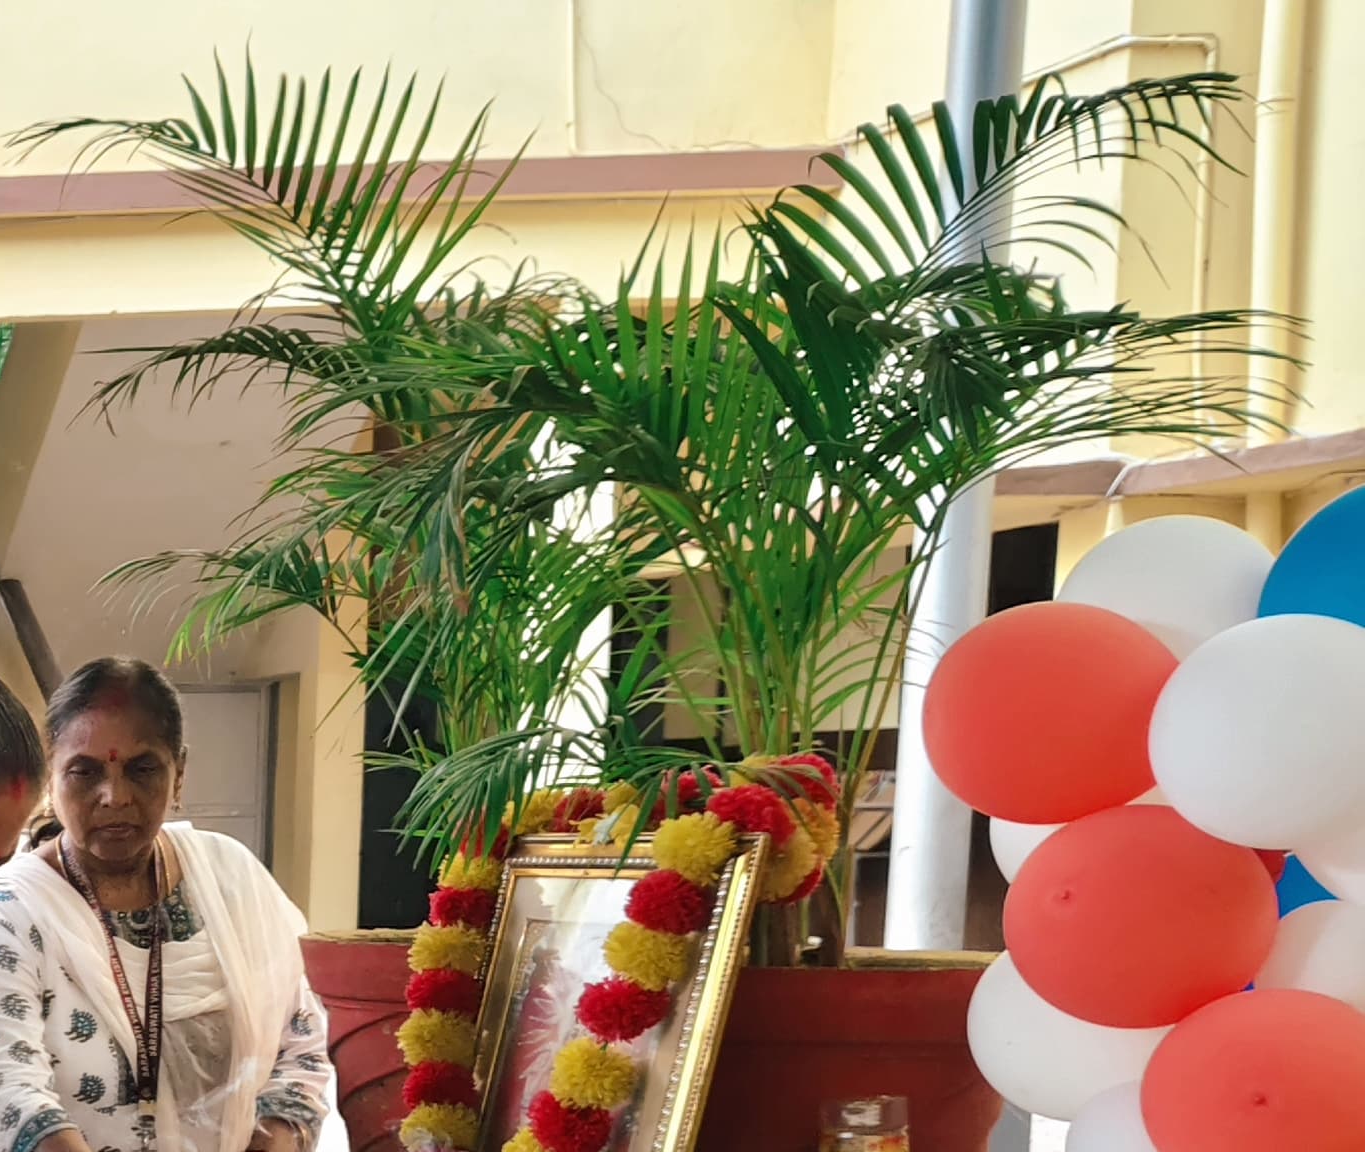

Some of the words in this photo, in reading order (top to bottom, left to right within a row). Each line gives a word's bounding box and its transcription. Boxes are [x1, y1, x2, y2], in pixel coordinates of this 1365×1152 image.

[111, 957, 129, 995] ENGLISH
[149, 974, 159, 1003] VIHAR
[124, 996, 138, 1023] VIHAR
[149, 1003, 158, 1057] SARASWATI
[133, 1024, 149, 1077] SARASWATI
